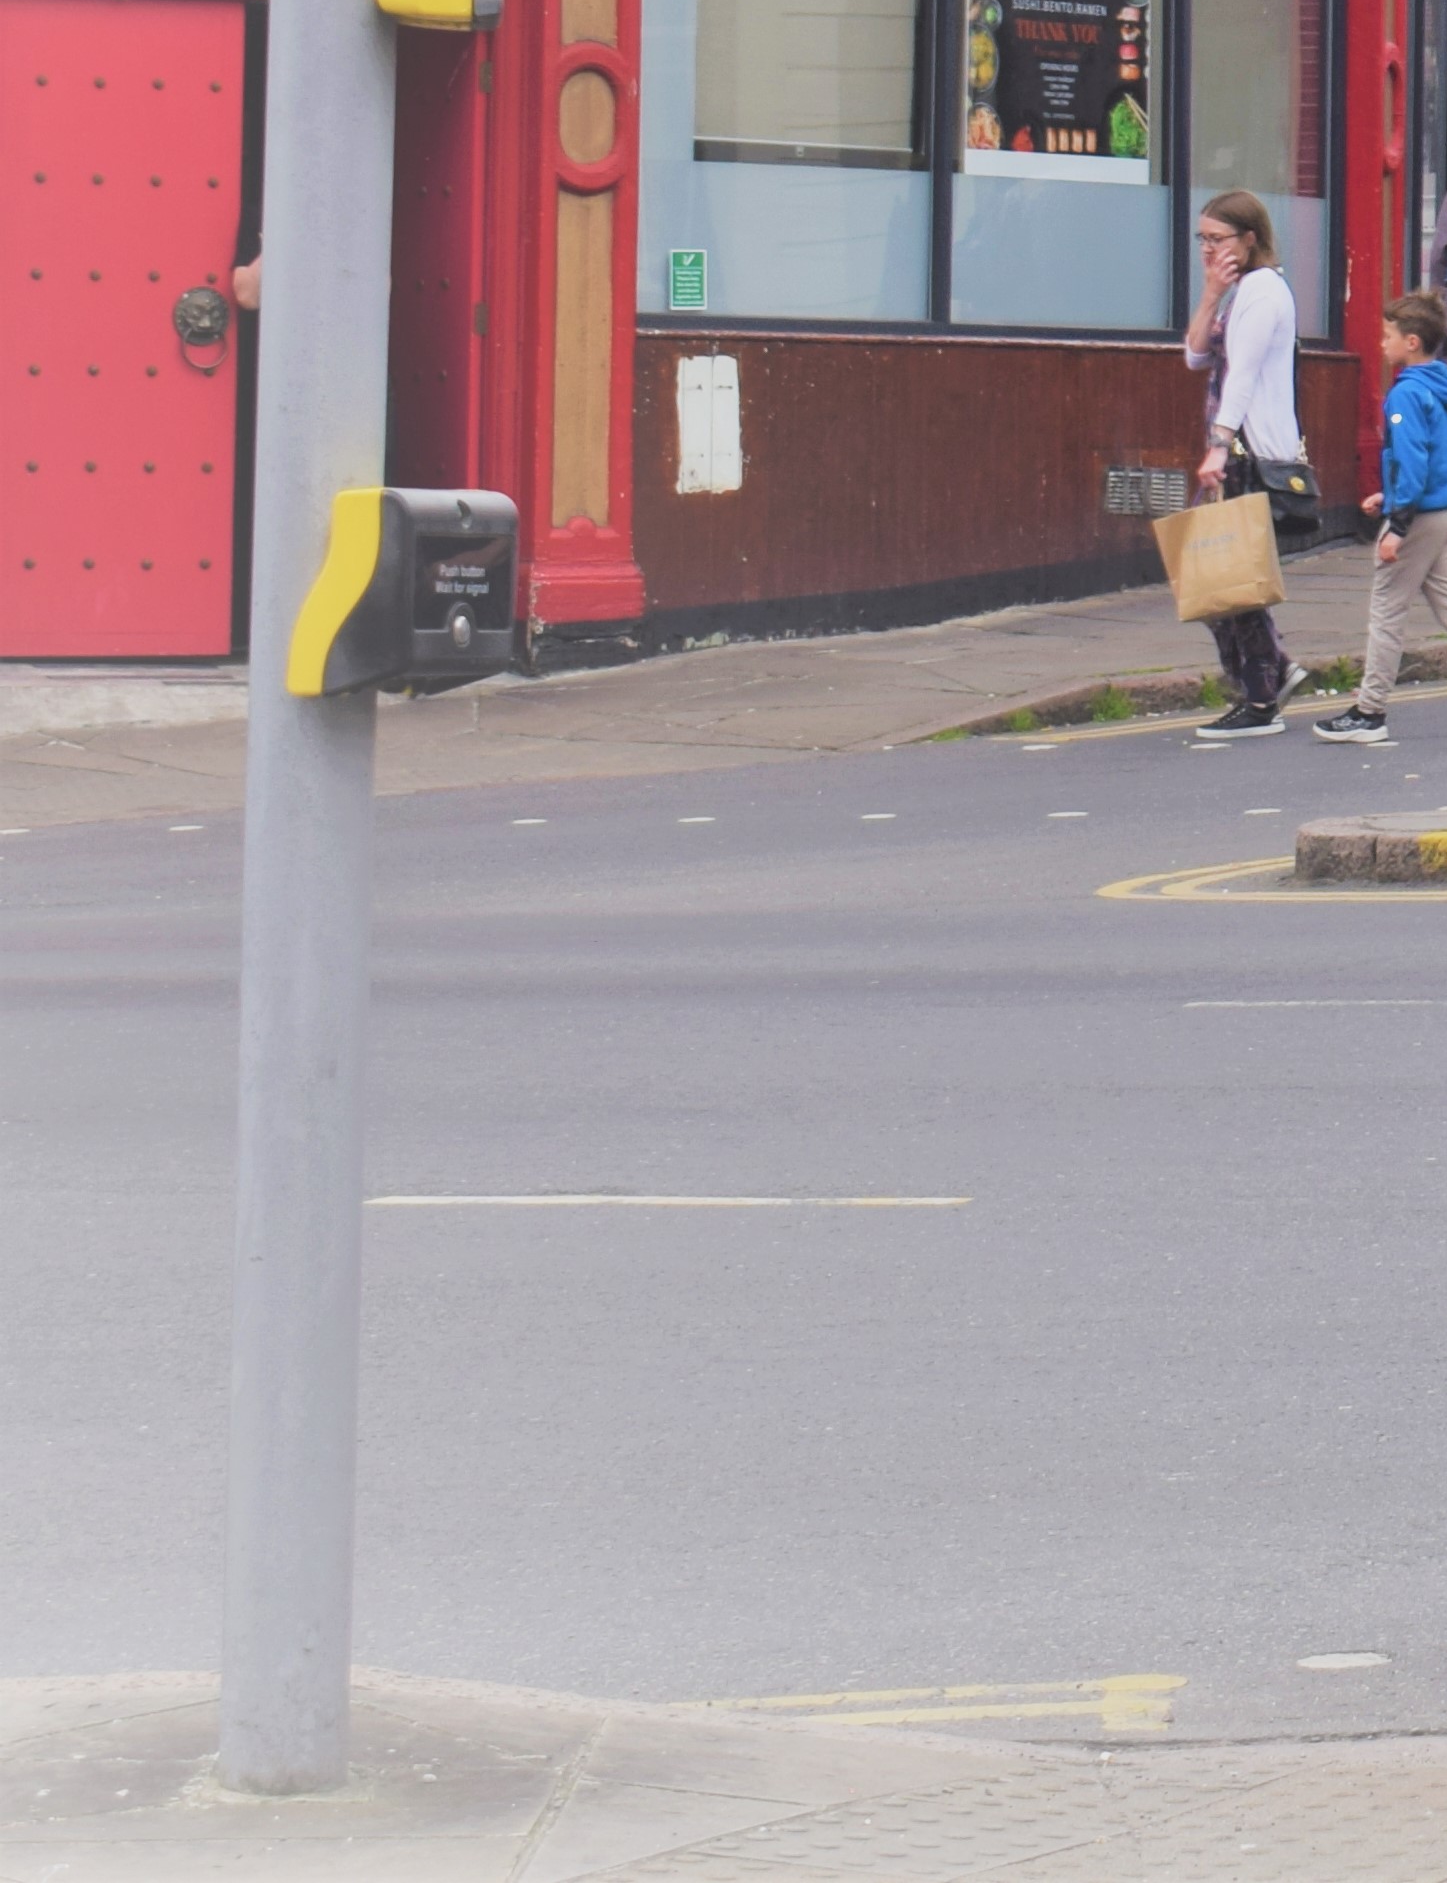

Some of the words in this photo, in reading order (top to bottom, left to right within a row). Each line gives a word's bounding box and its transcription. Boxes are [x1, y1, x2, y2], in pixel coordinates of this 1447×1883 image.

[1016, 19, 1066, 41] THANK
[438, 564, 459, 577] Push
[461, 565, 486, 577] button
[435, 581, 455, 593] Wait
[457, 581, 465, 593] for
[466, 581, 490, 596] signal
